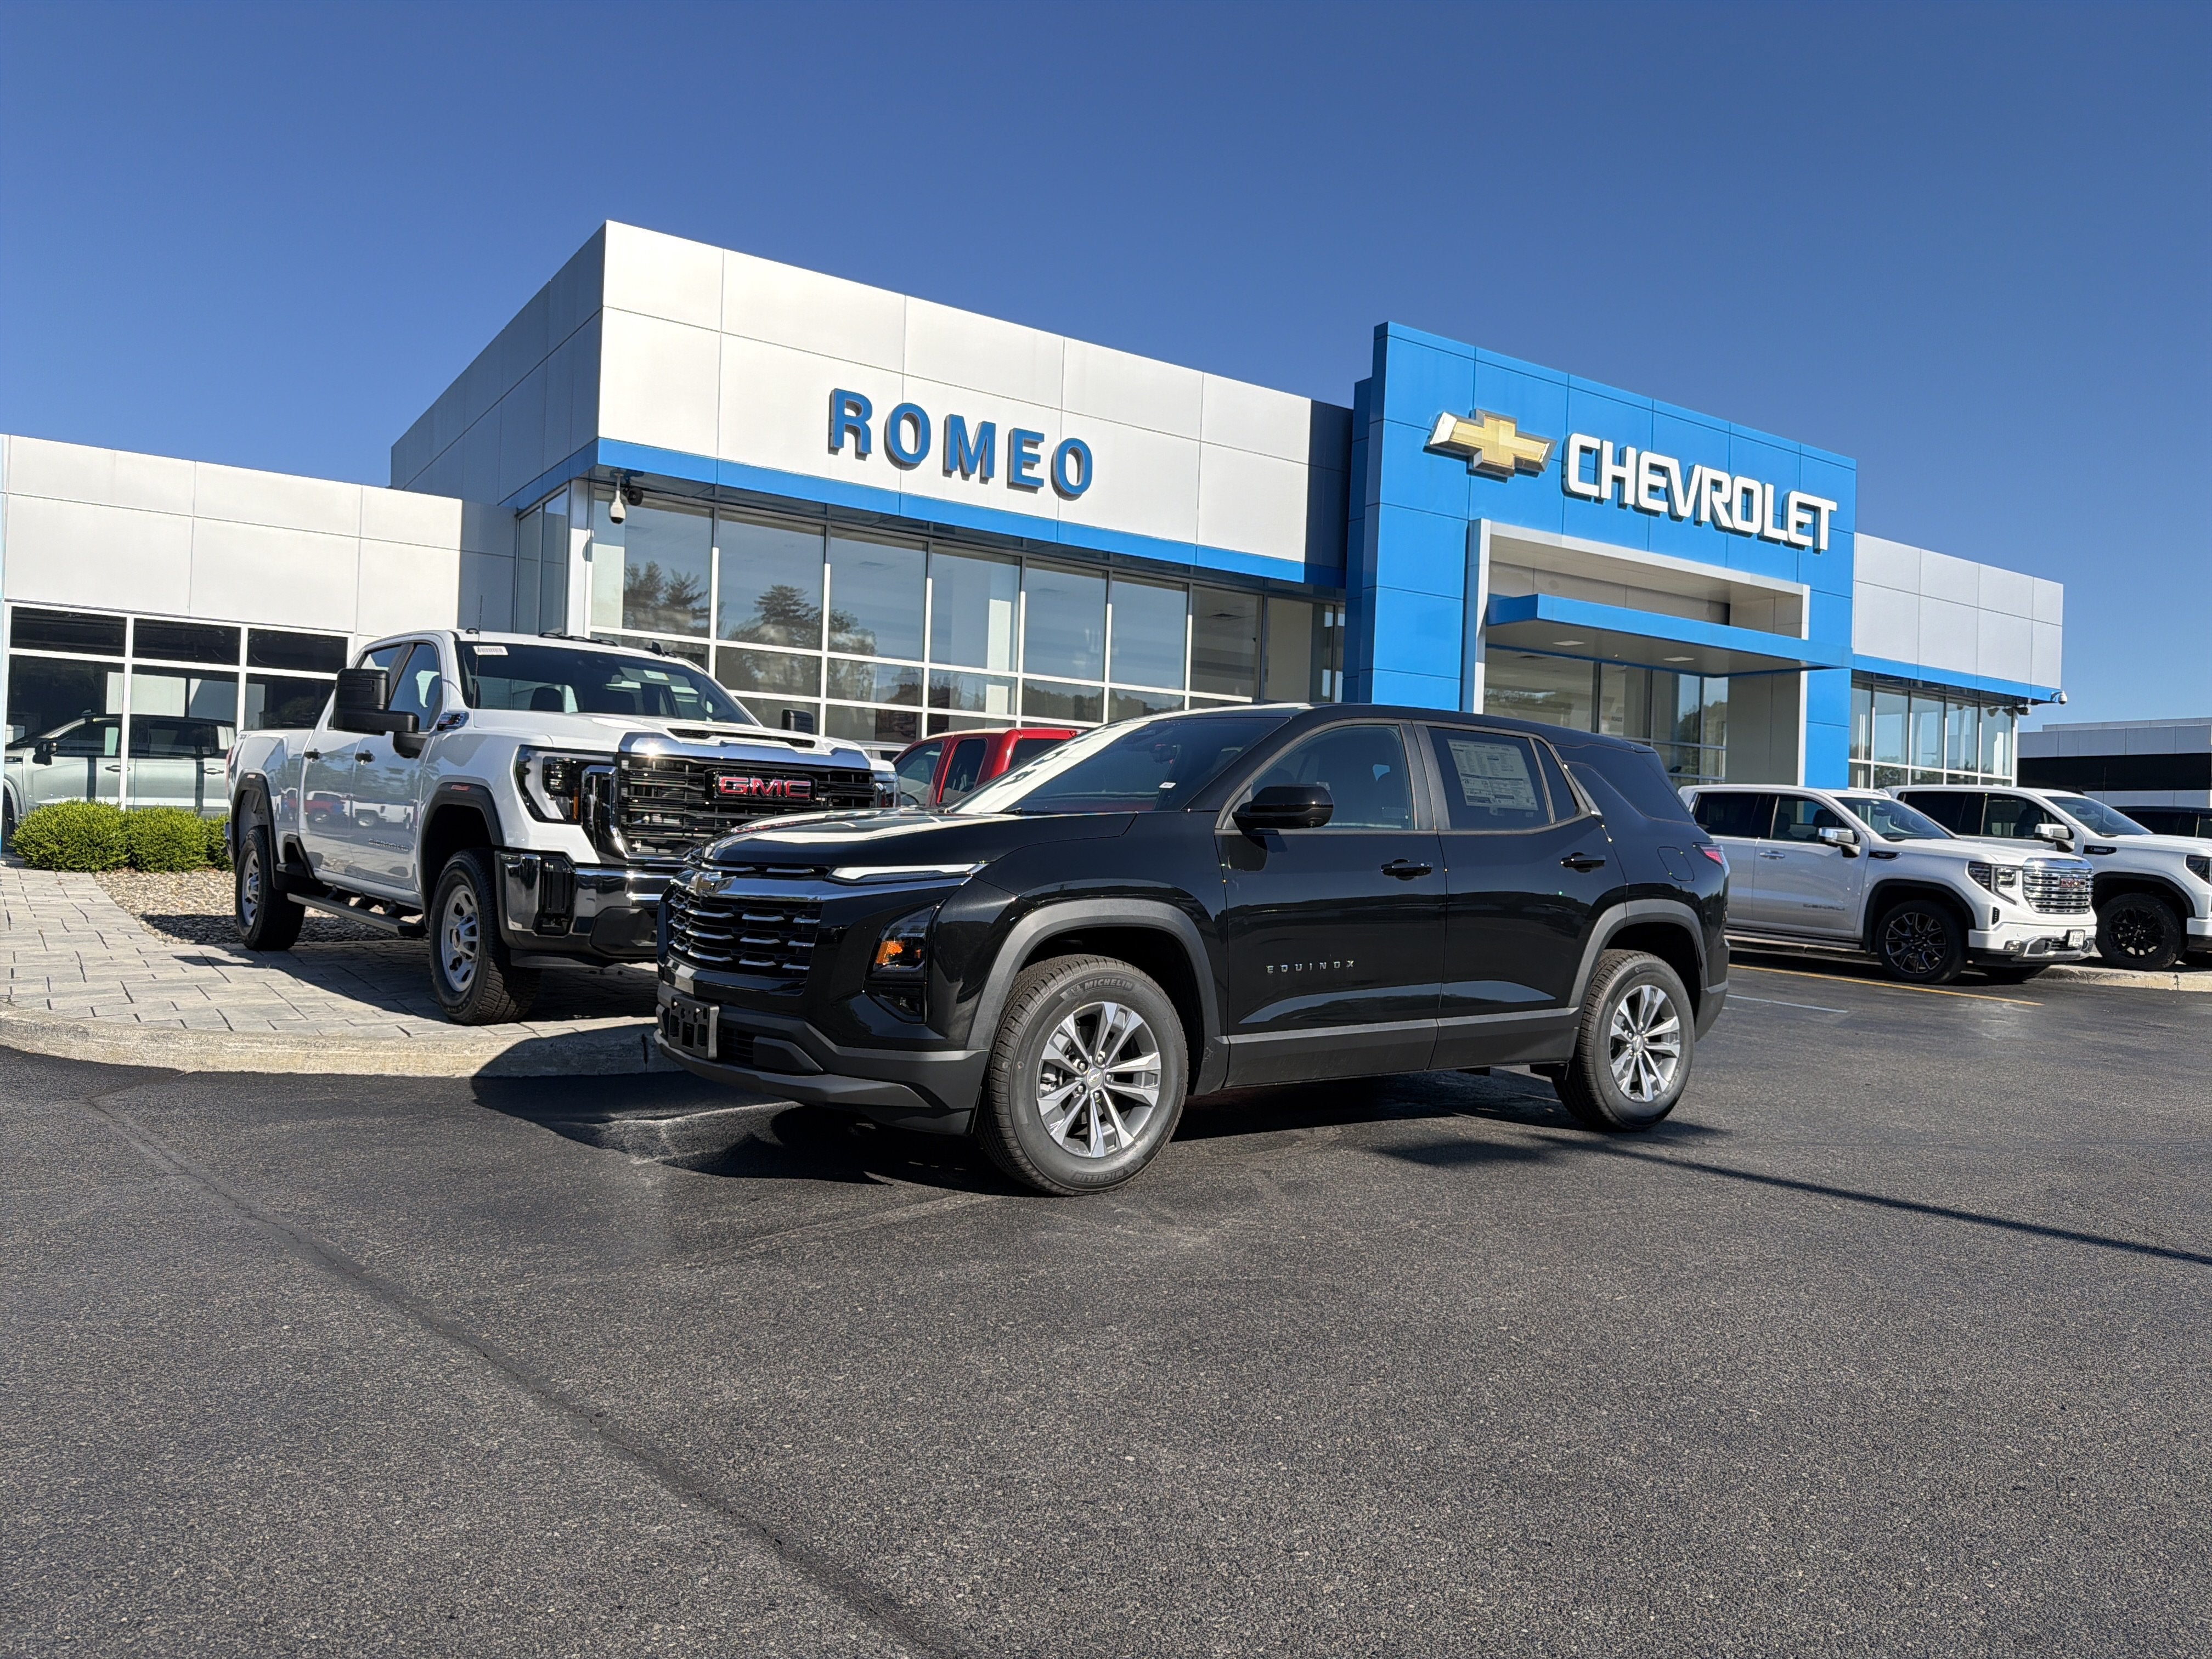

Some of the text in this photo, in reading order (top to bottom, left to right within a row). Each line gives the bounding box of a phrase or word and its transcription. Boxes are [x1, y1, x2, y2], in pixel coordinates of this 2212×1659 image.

[829, 388, 1093, 497] ROMEO
[1565, 432, 1837, 551] CHEVROLET
[719, 776, 811, 798] GMC
[1266, 960, 1355, 974] EQUINOX
[1084, 978, 1133, 991] MICHELIN
[1073, 1168, 1125, 1183] MICHELIN
